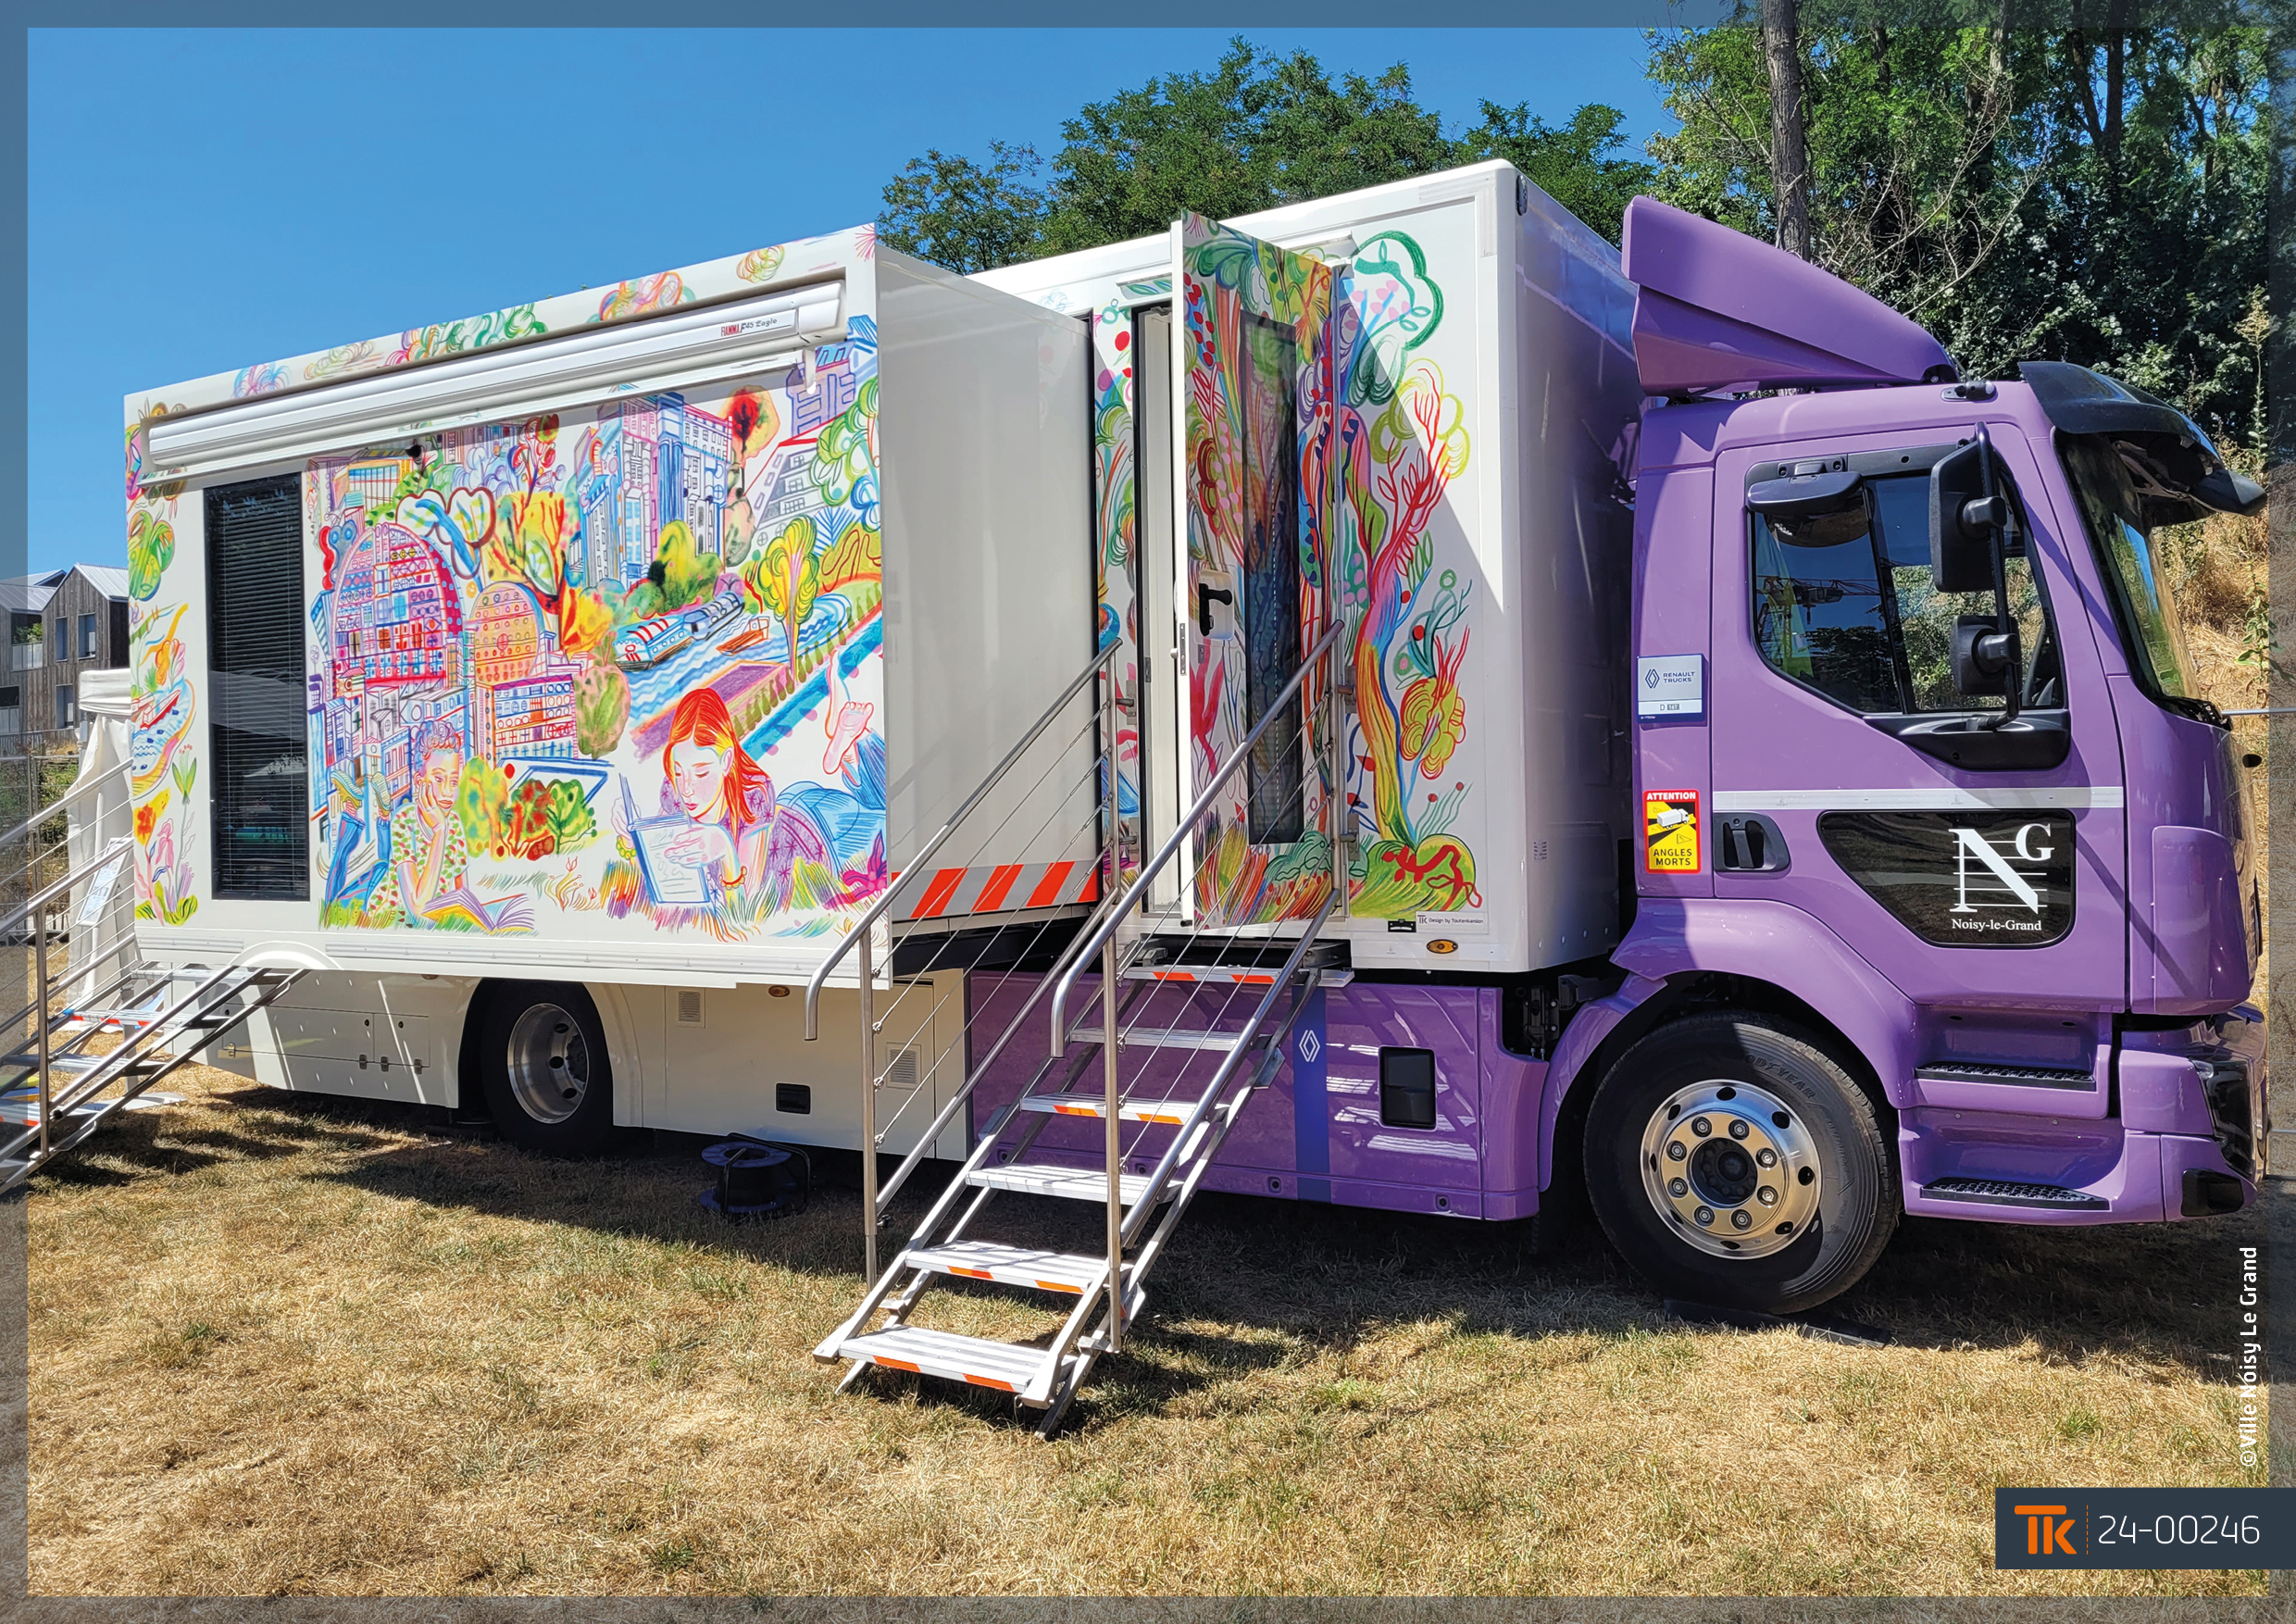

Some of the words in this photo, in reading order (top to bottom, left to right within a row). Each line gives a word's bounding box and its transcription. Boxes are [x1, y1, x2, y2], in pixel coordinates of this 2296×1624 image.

[721, 323, 740, 336] FIAMMA
[755, 318, 778, 328] Eagle
[1646, 792, 1696, 801] ATTENTION
[1653, 848, 1692, 856] ANGLES
[1655, 857, 1691, 866] MORTS
[1952, 918, 2042, 932] Noisy-le-Grand
